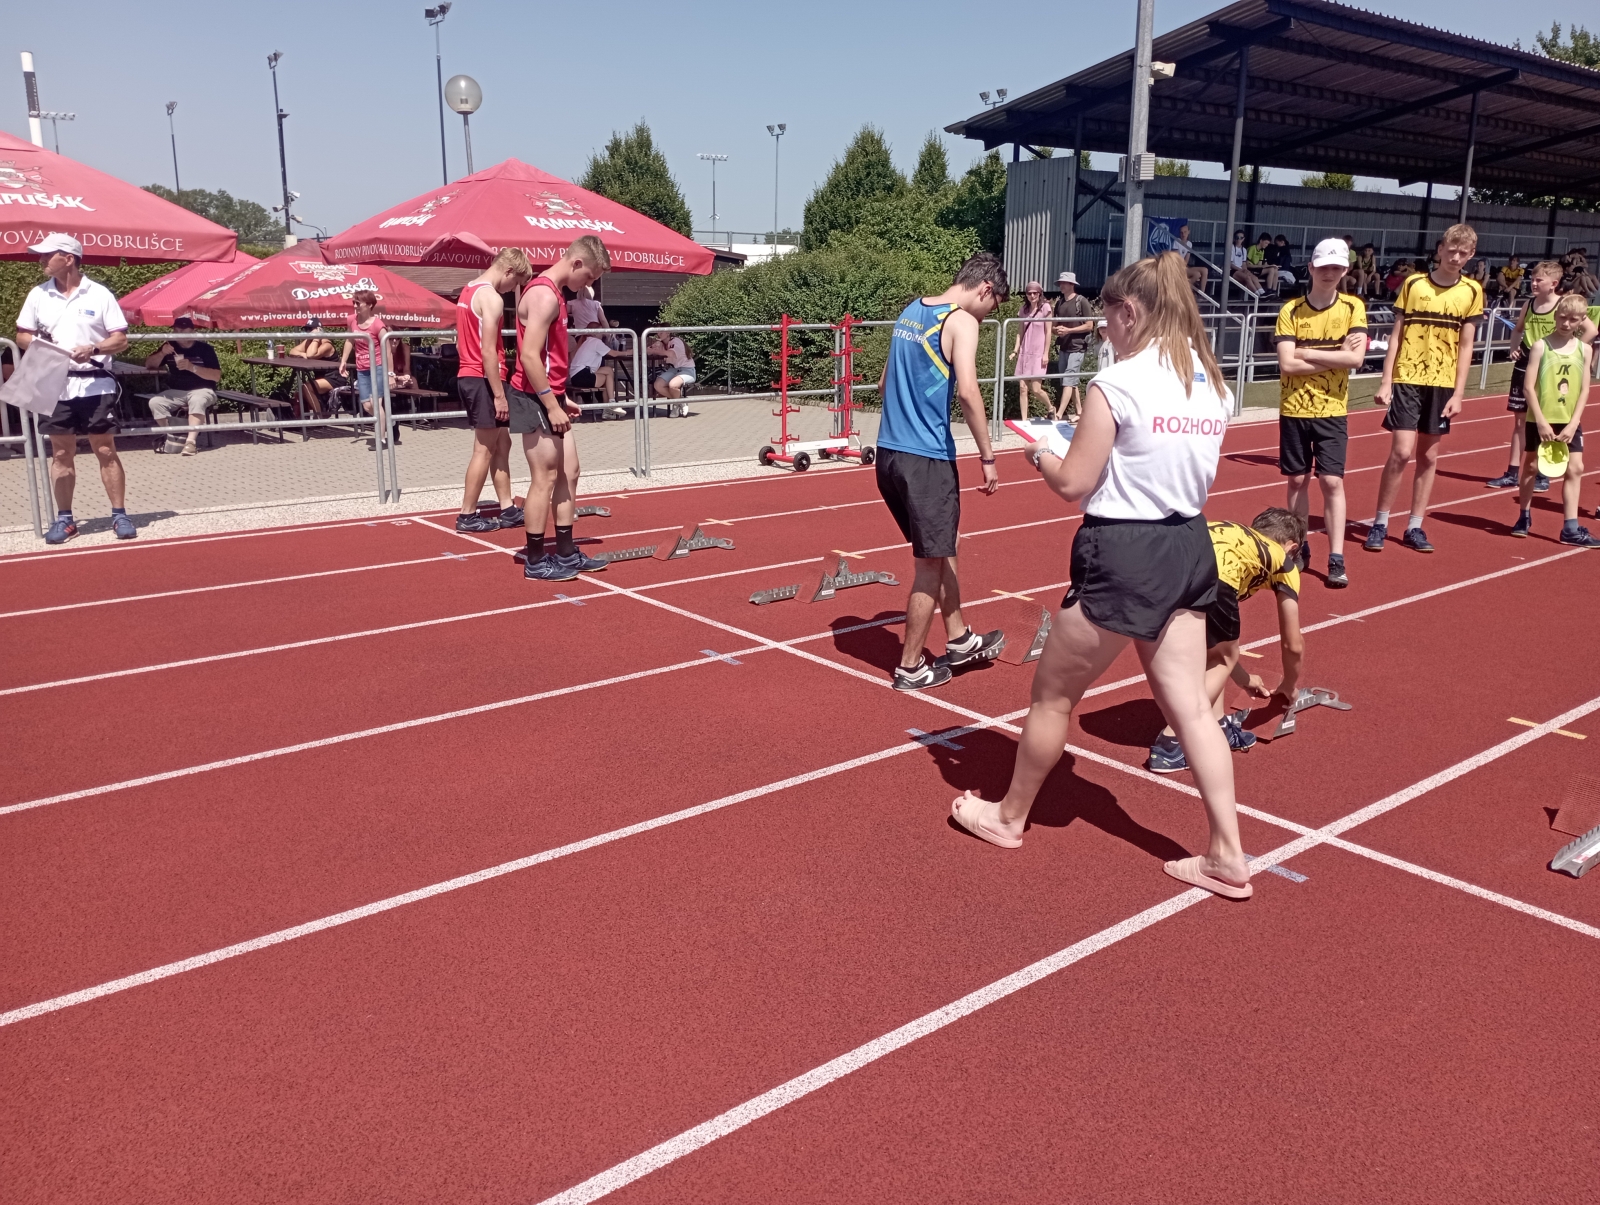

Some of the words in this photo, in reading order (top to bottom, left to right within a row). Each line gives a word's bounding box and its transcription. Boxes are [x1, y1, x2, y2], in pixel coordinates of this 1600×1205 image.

[0, 192, 97, 212] PUŠÁK
[0, 229, 58, 245] OVA
[83, 232, 184, 251] DOBRUŠCE
[362, 243, 389, 256] PIVOVAR
[614, 250, 622, 261] V
[624, 251, 685, 266] DOBRUŠCE
[240, 310, 348, 322] www.pivovardobruska.cz
